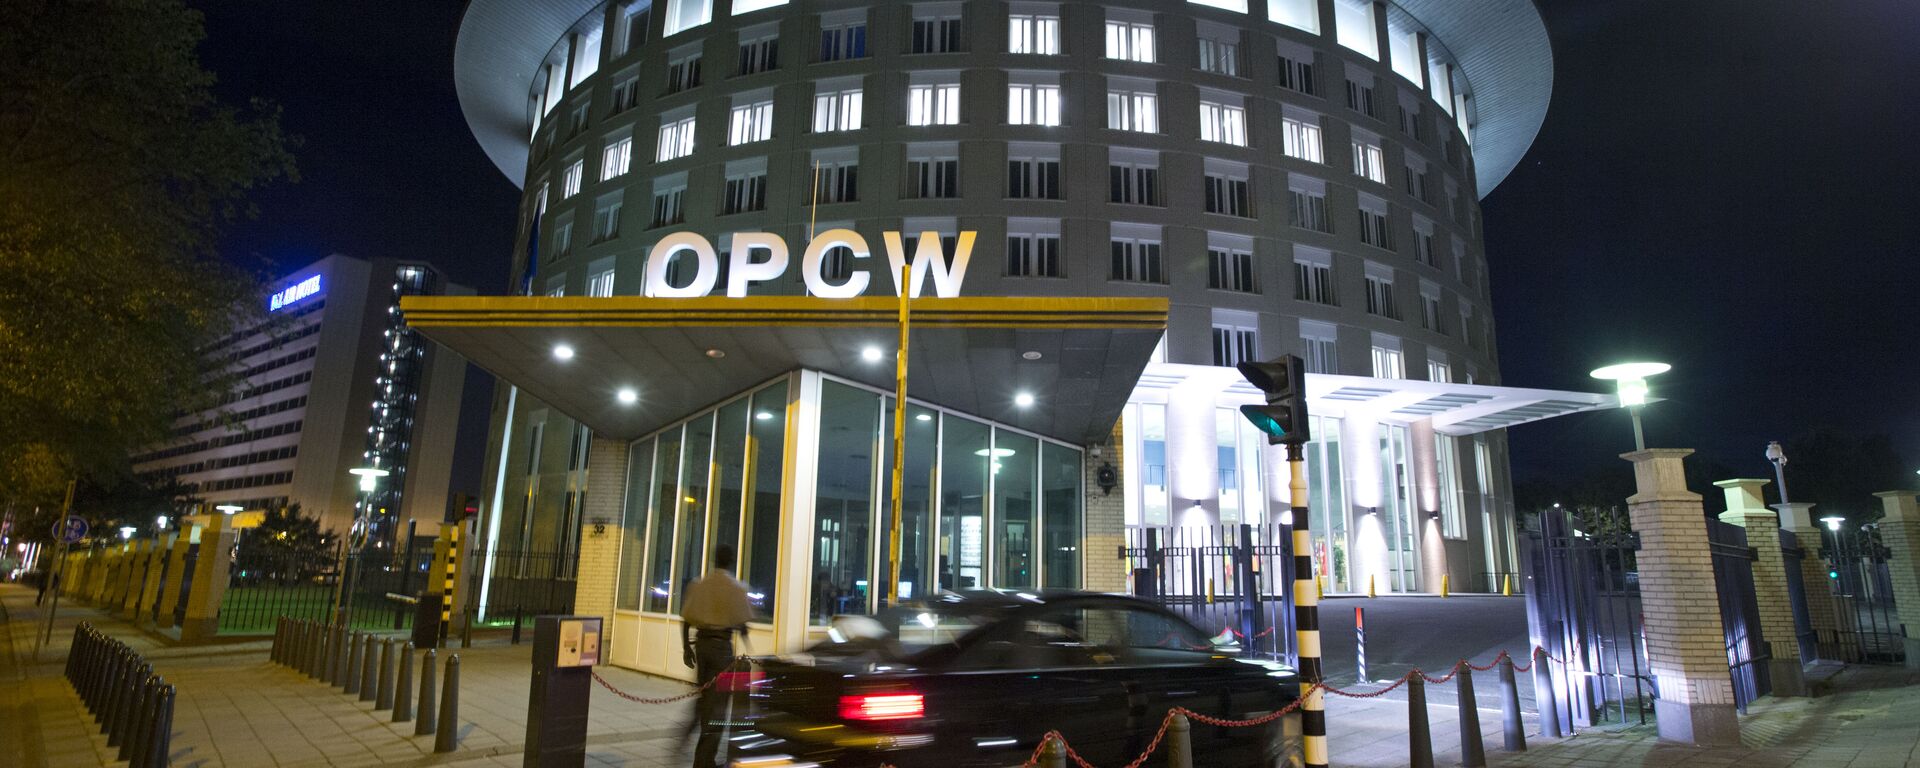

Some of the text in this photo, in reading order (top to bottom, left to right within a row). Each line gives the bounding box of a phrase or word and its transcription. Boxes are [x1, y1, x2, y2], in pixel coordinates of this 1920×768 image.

[646, 228, 977, 299] OPCW
[295, 274, 321, 301] HOTEL
[593, 523, 605, 535] 32
